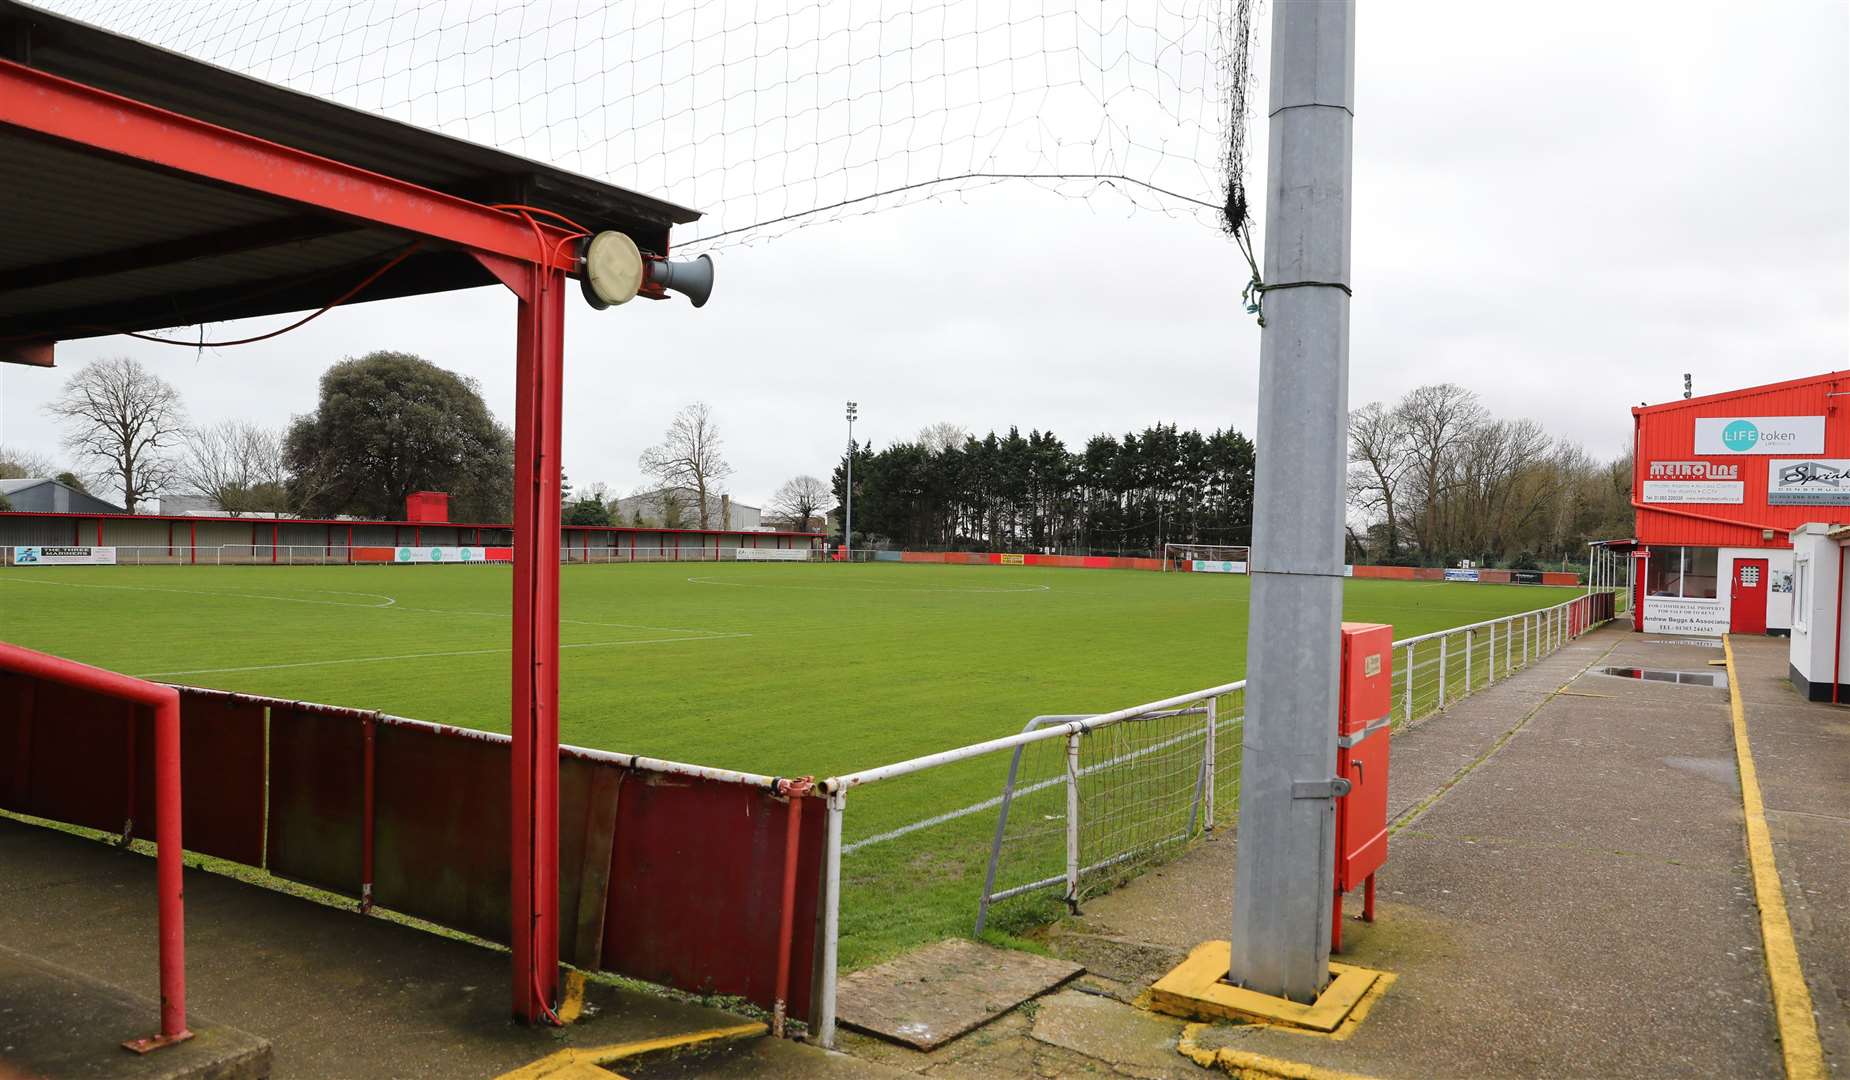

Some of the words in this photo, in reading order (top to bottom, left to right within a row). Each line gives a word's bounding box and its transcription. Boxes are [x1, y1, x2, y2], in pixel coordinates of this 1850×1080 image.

[1725, 430, 1756, 441] LIFE
[1760, 430, 1796, 441] token
[1695, 617, 1730, 625] Associates
